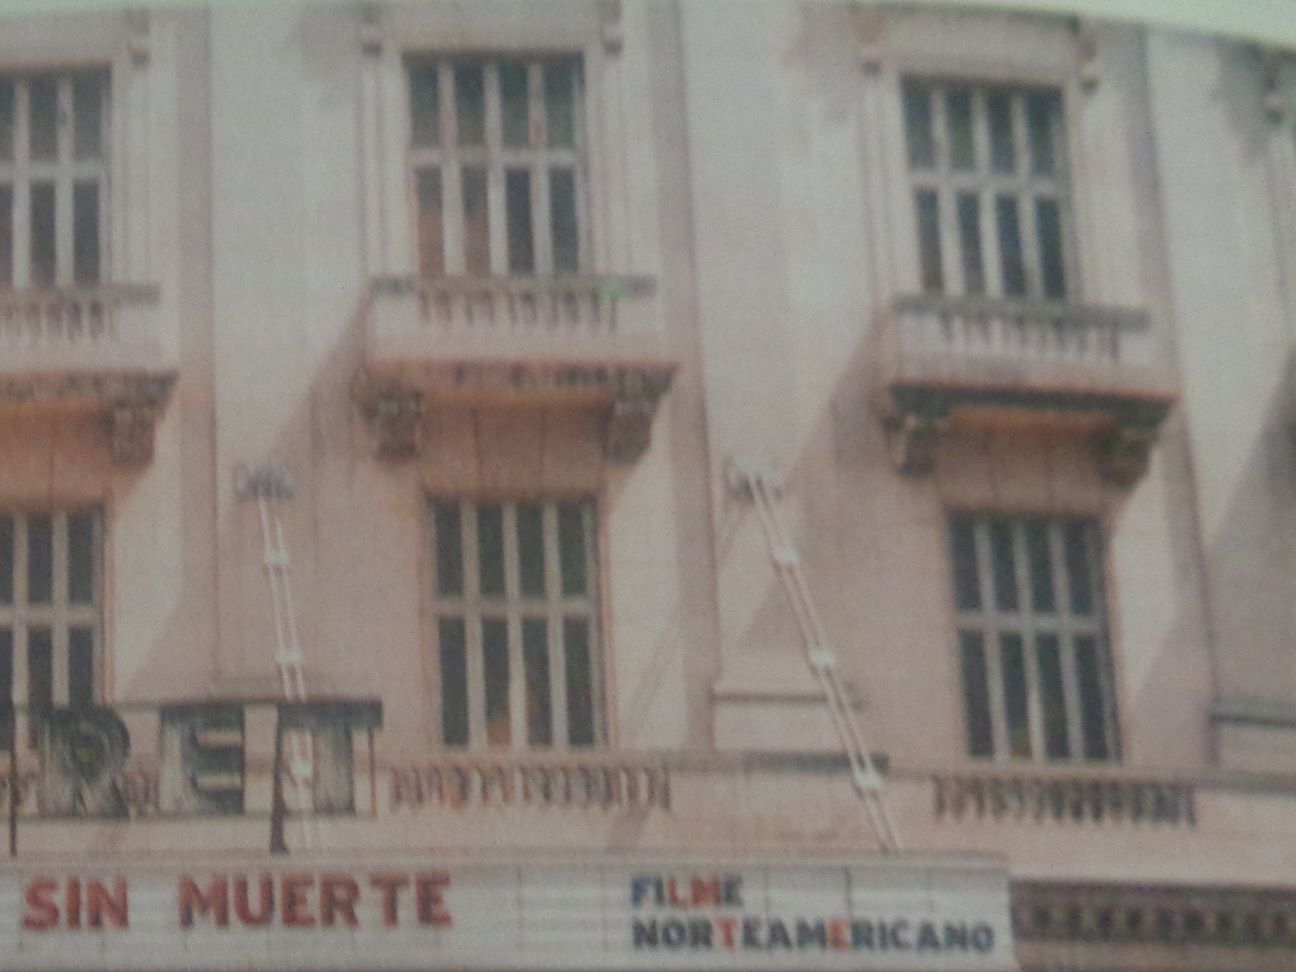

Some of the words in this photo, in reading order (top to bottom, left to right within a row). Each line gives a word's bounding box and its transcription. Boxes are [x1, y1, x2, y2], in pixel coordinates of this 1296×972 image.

[22, 874, 129, 929] SIN
[177, 872, 453, 928] MUERTE
[631, 875, 742, 908] FILME
[632, 916, 995, 953] NORTEAMERICANO
